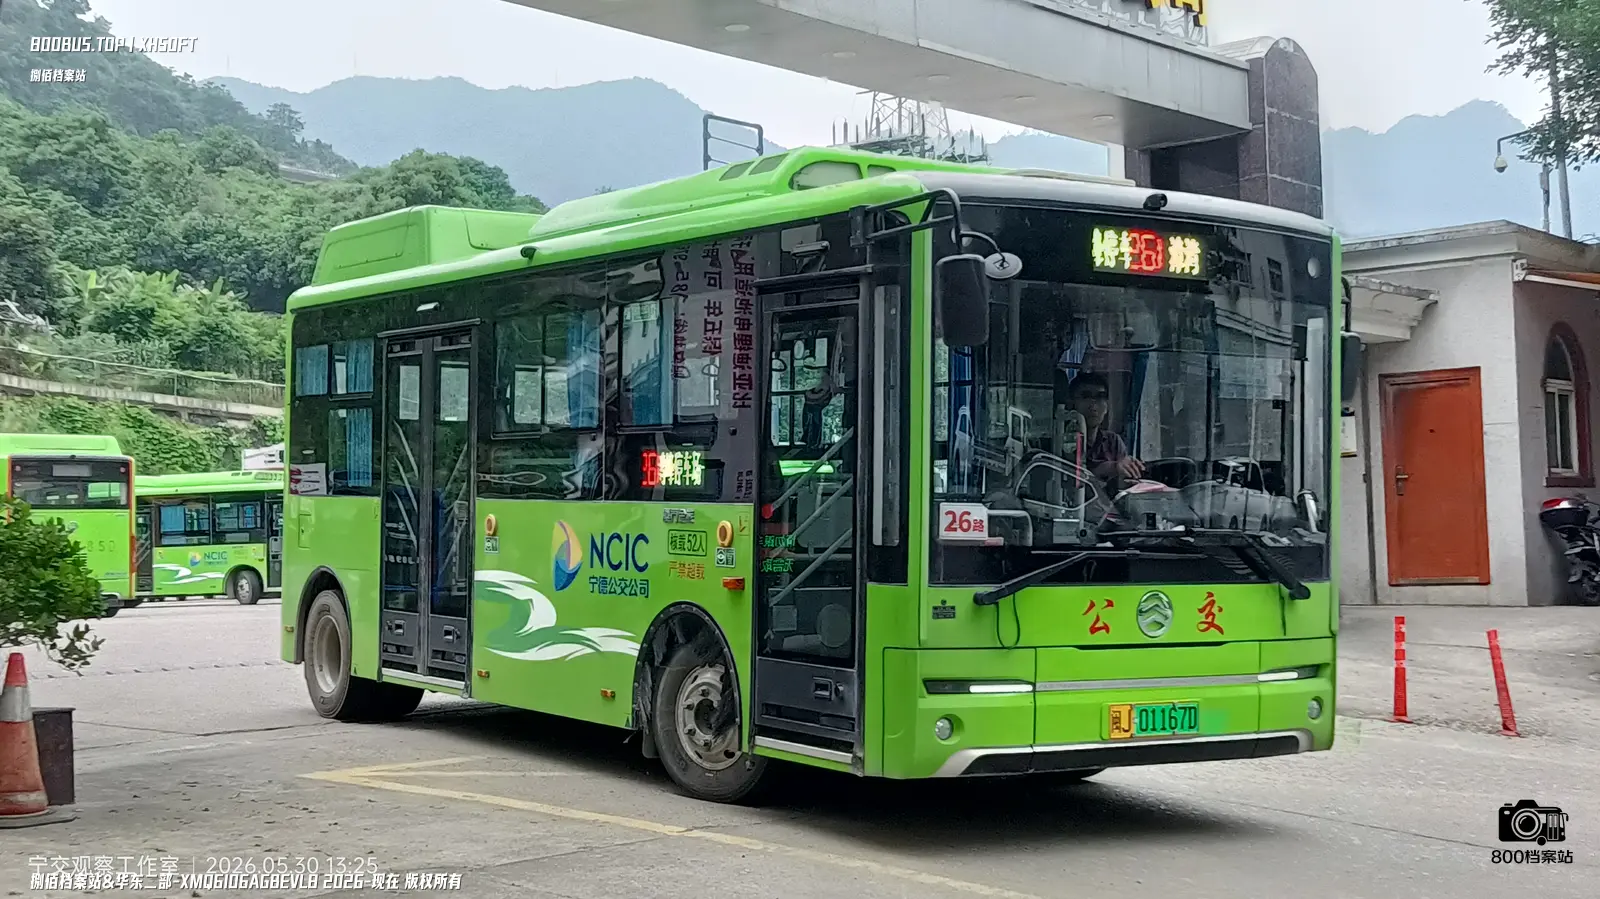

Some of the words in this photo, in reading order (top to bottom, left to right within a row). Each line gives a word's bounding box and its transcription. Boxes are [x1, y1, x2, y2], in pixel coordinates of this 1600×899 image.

[944, 510, 985, 533] 26路
[203, 550, 228, 560] NCIC
[589, 532, 650, 573] NCIC
[668, 561, 705, 580] 严禁超载
[588, 575, 650, 599] 宁德公交公司
